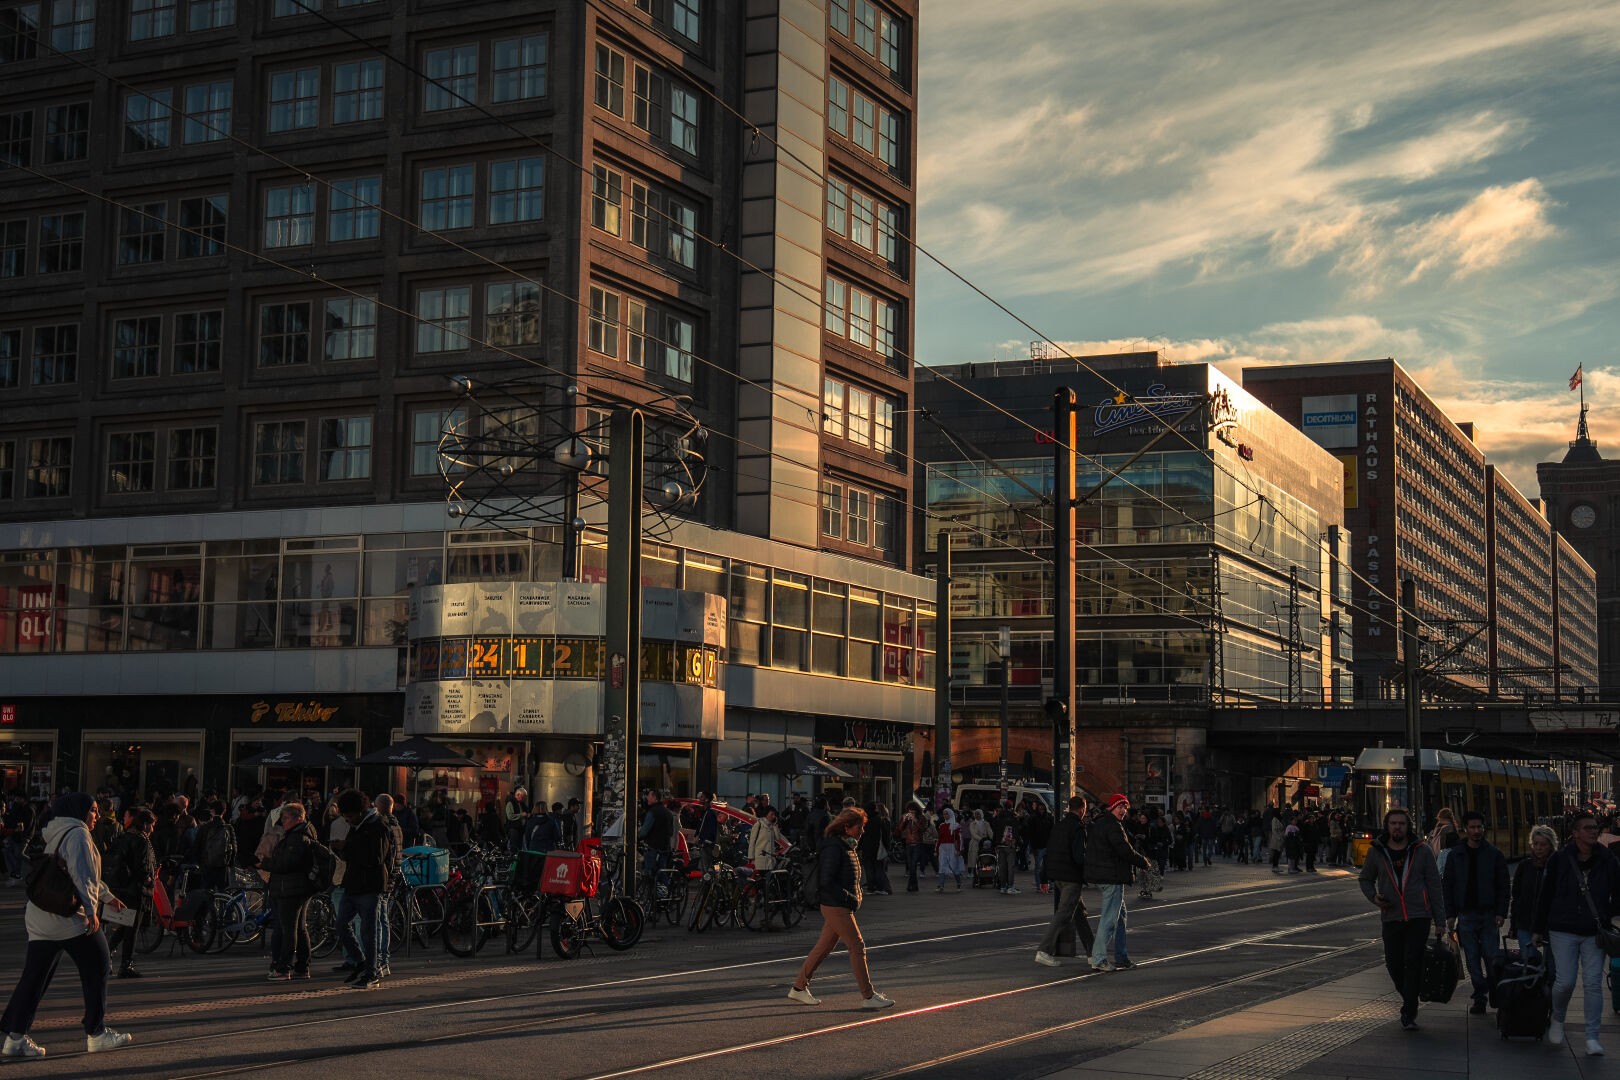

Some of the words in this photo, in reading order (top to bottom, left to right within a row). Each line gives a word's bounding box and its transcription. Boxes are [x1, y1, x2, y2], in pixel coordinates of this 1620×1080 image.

[1306, 414, 1354, 424] DECATHLON
[1365, 393, 1378, 480] RATHAUS
[1367, 535, 1381, 637] PASSAGEN
[468, 644, 498, 668] 24
[513, 644, 526, 668] 1
[551, 645, 572, 669] 2
[692, 652, 702, 677] 6
[707, 654, 715, 678] 7
[274, 701, 339, 722] Tchibo
[1319, 767, 1328, 779] U
